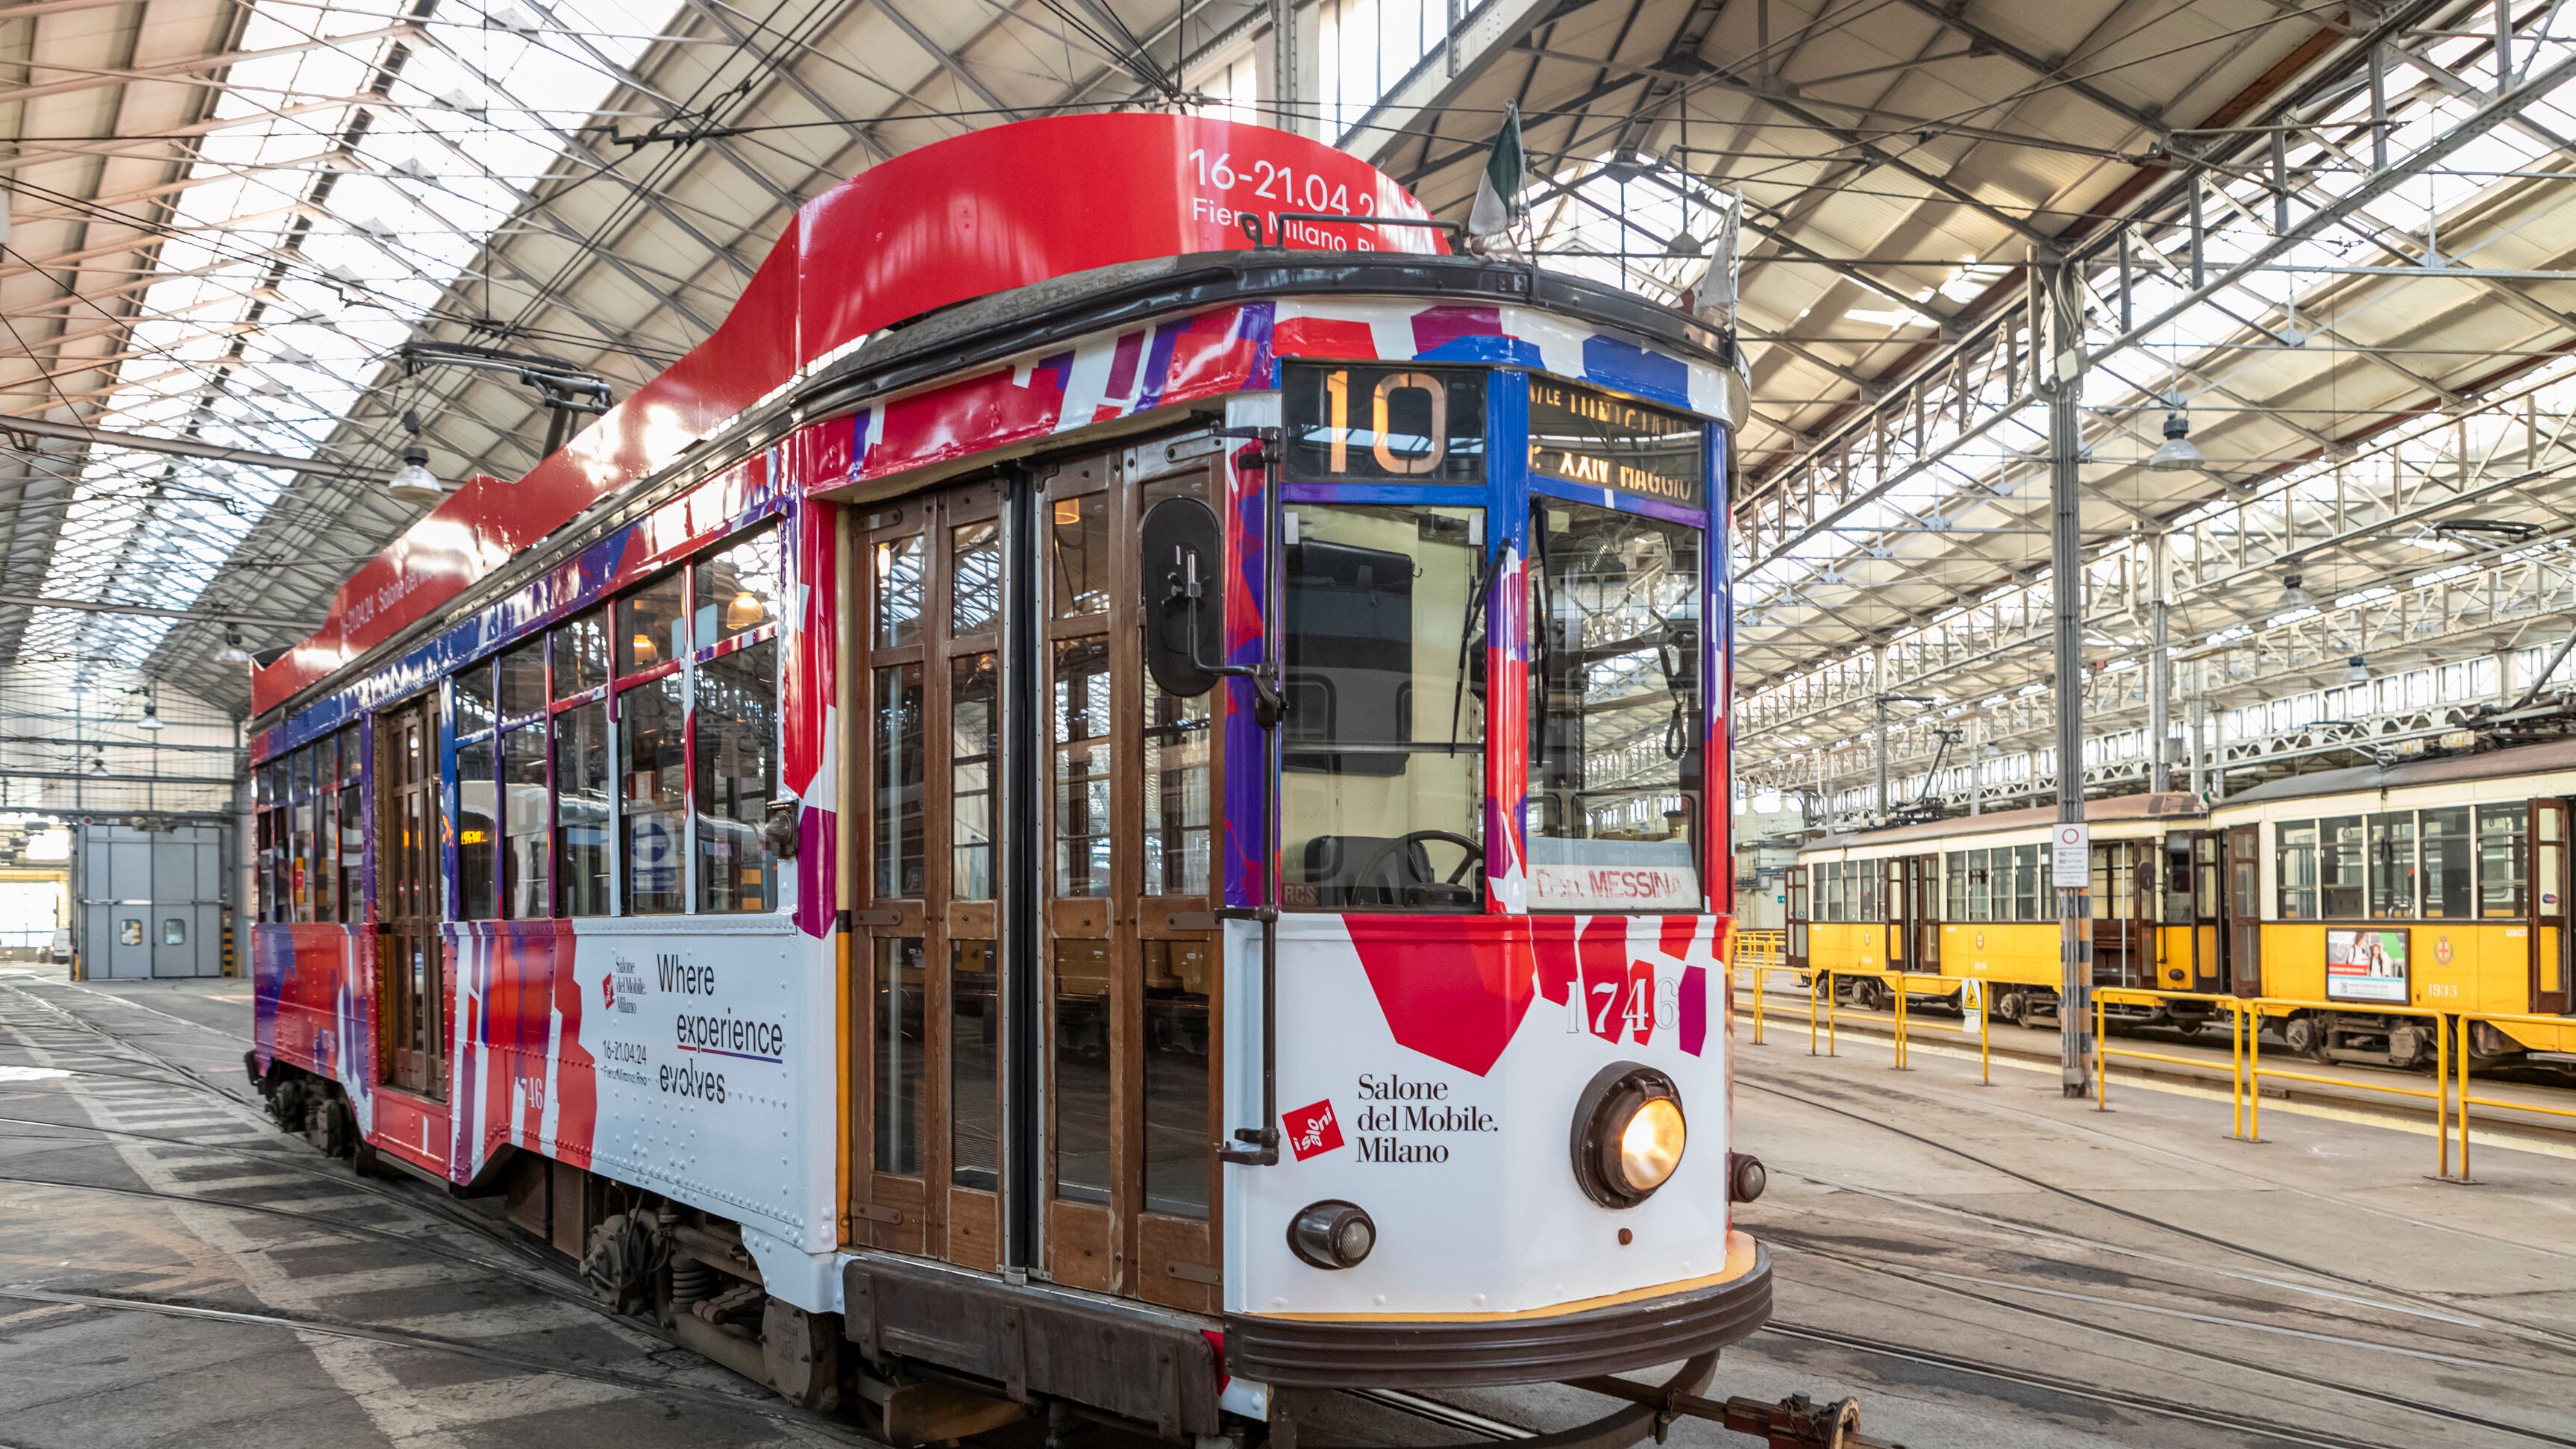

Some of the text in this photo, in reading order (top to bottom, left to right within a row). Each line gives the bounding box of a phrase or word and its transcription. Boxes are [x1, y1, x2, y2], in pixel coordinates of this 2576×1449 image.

[1193, 197, 1257, 231] Fier
[1326, 370, 1447, 475] 10
[1619, 465, 1692, 501] MAGGIO
[656, 954, 715, 996] Where
[1565, 976, 1681, 1034] 1746
[677, 1007, 783, 1057] experience
[603, 1039, 647, 1065] 16-21.04.24
[659, 1058, 726, 1104] evolves
[1358, 1073, 1449, 1101] Salone
[1357, 1105, 1499, 1133] del Mobile.
[1355, 1136, 1450, 1163] Milano
